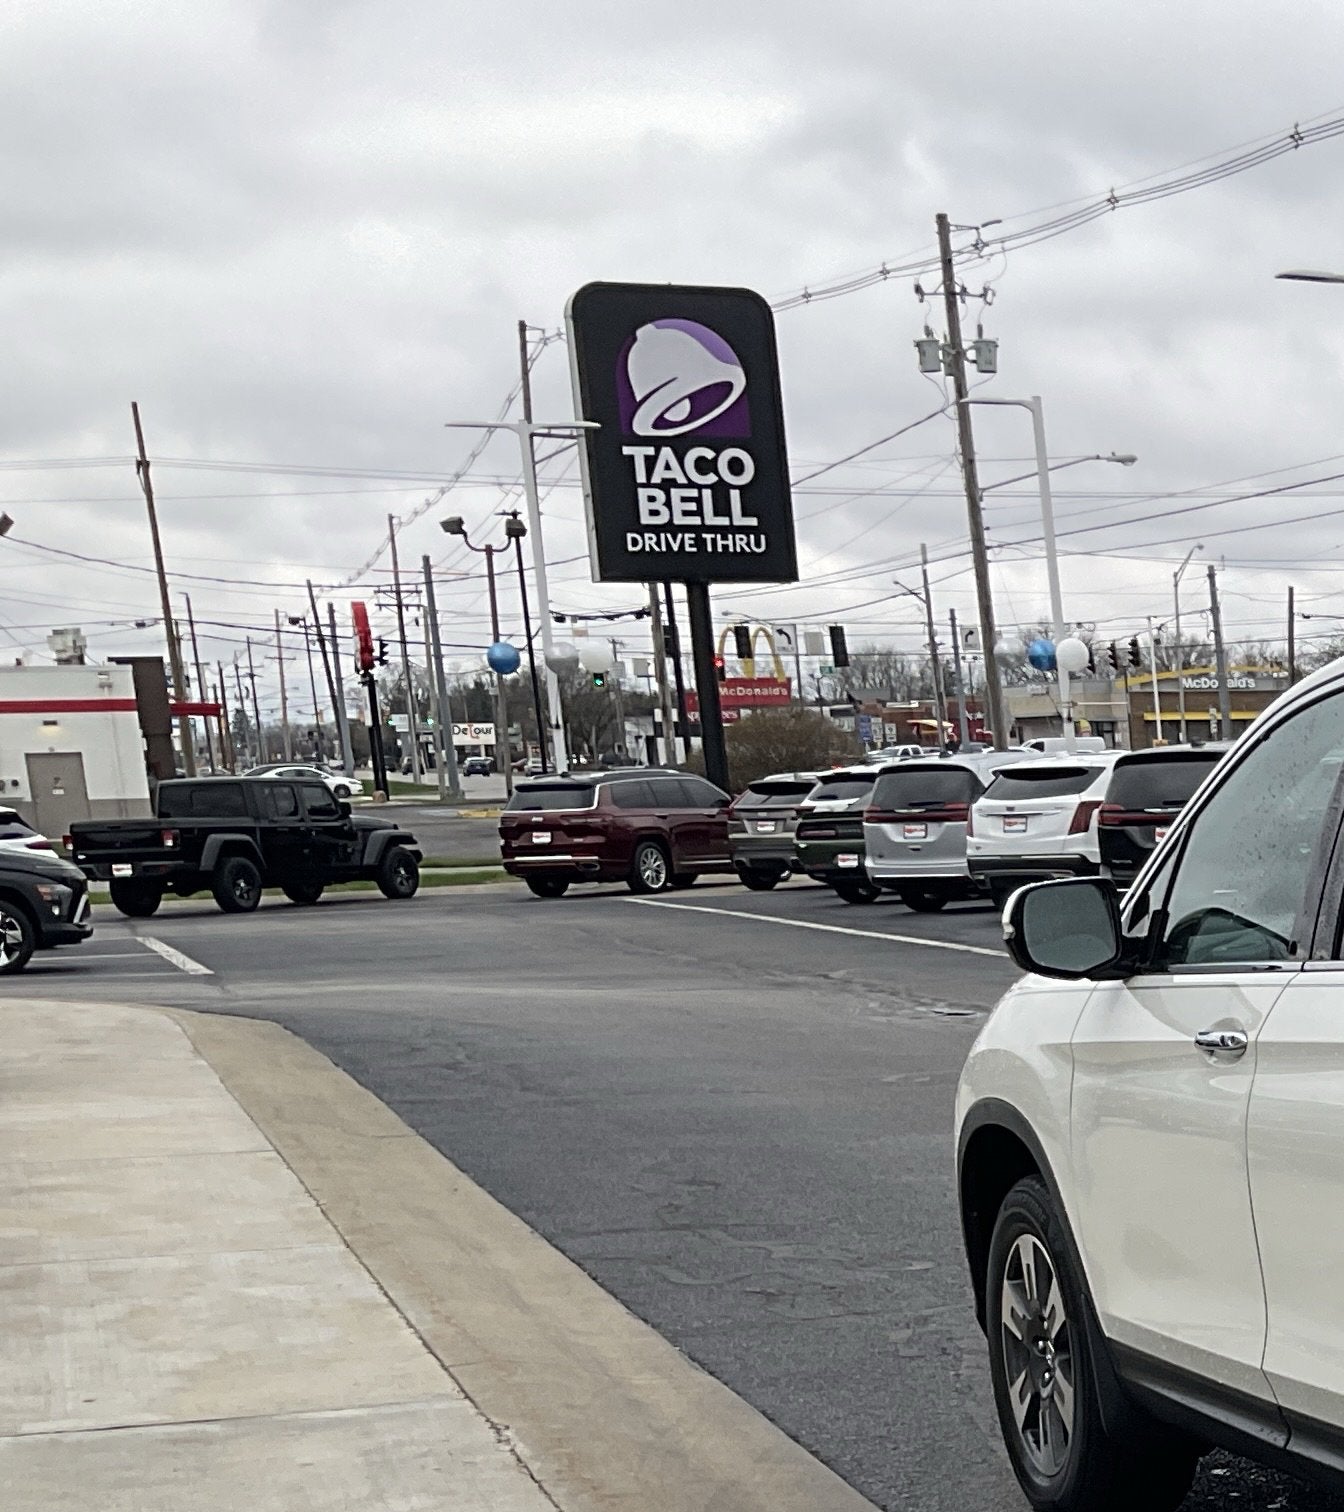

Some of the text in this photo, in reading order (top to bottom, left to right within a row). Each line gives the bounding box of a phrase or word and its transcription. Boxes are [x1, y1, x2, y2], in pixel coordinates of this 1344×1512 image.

[622, 445, 755, 486] TACO
[637, 487, 758, 527] BELL
[626, 533, 766, 553] DRIVE THRU
[719, 686, 788, 697] McDonald's
[1181, 677, 1256, 689] McDoald's
